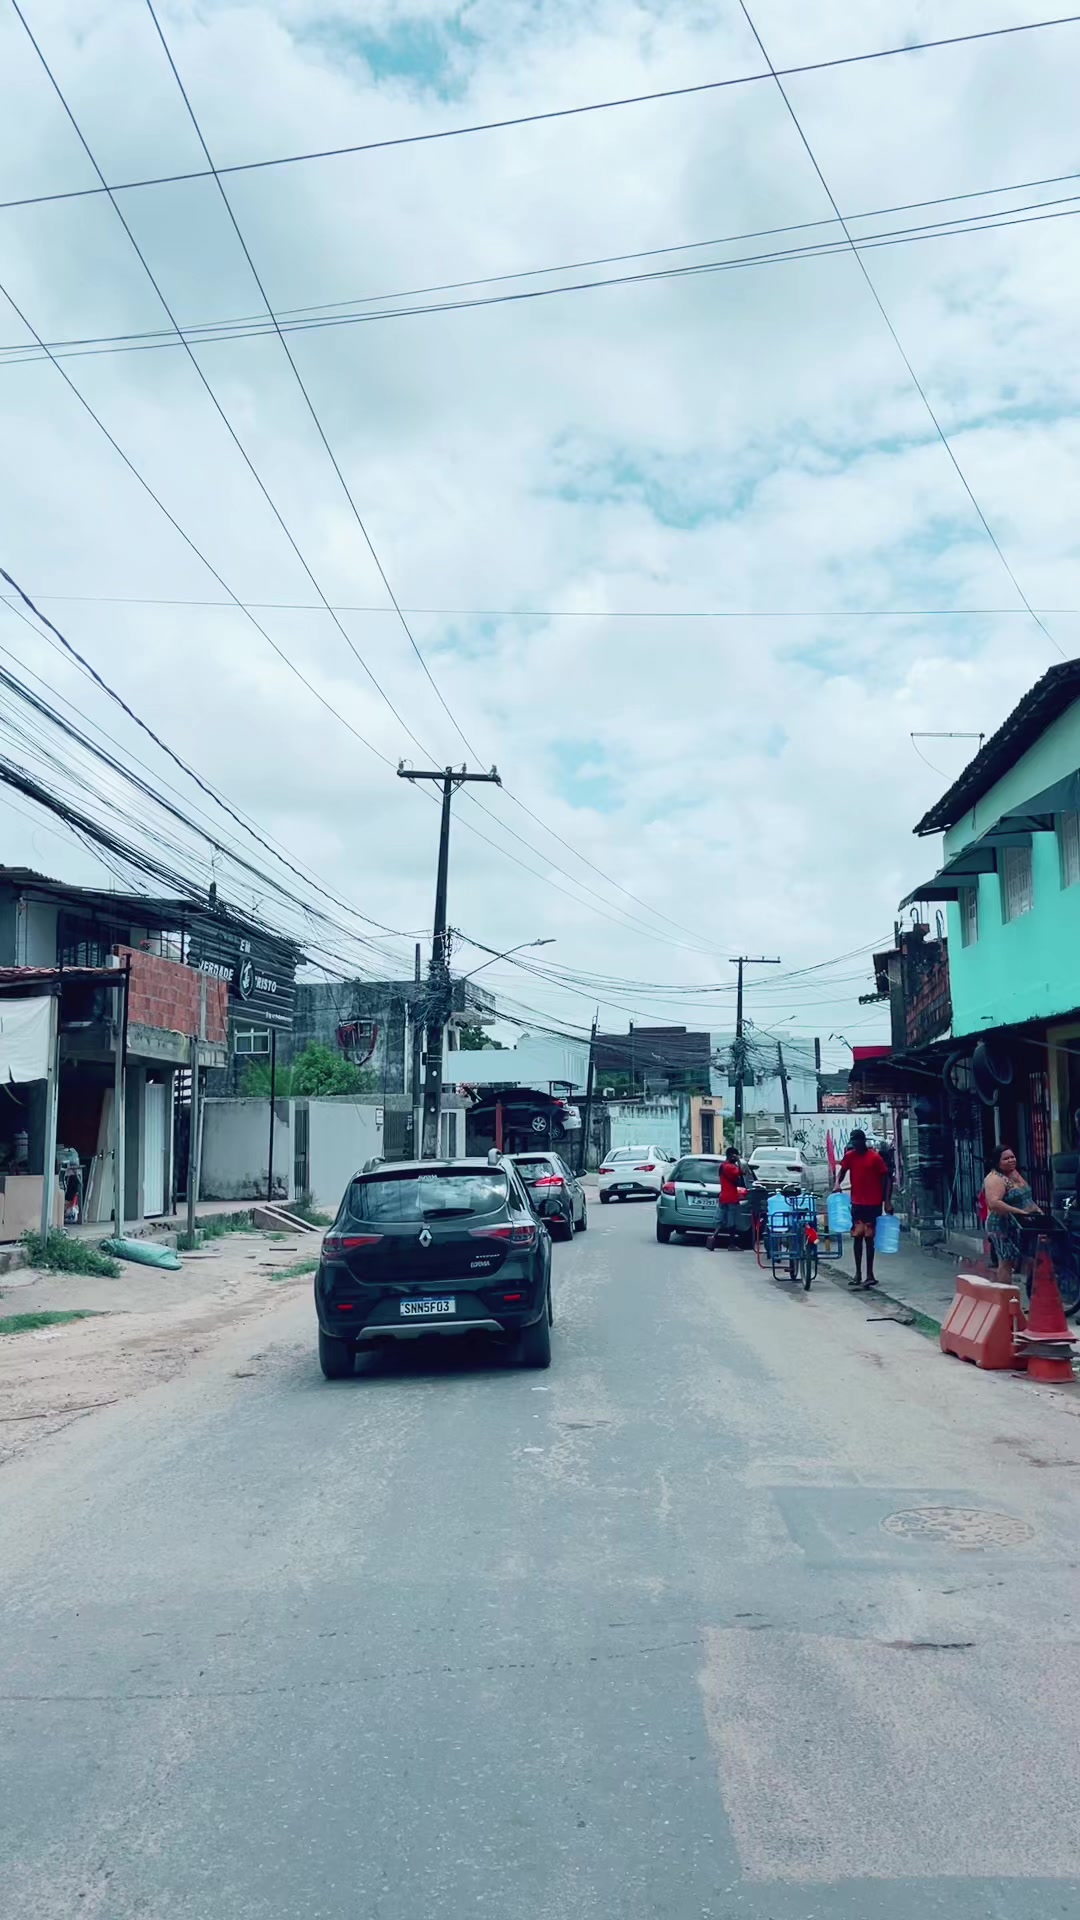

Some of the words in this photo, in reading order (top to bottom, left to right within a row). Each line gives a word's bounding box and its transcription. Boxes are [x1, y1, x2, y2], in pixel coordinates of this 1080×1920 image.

[240, 938, 251, 953] EM
[255, 976, 277, 993] RISTO
[404, 1301, 450, 1314] SNN5F03
